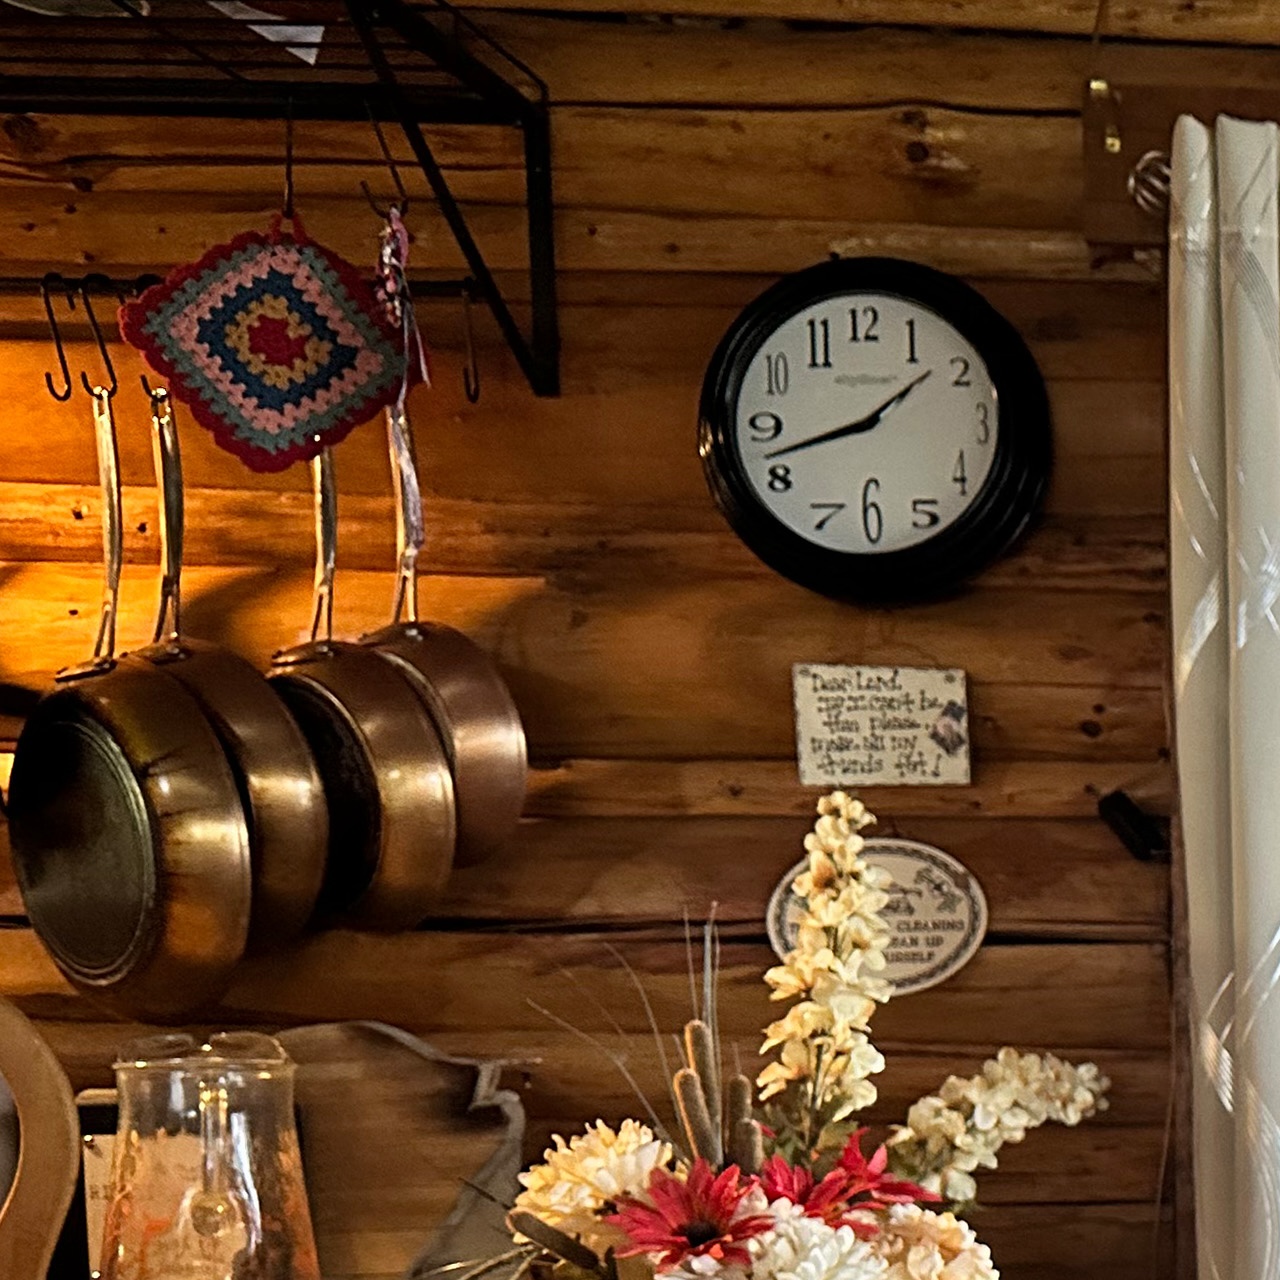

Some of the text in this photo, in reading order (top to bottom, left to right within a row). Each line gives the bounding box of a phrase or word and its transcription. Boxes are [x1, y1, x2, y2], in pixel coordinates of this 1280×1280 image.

[849, 306, 879, 342] 12
[905, 318, 919, 363] 1
[807, 318, 832, 369] 11
[766, 352, 789, 396] 10
[950, 357, 971, 387] 2
[749, 411, 783, 442] 9
[975, 402, 989, 446] 3
[768, 464, 793, 493] 8
[952, 449, 967, 496] 4
[810, 503, 846, 531] 7
[862, 477, 883, 544] 6
[912, 500, 939, 529] 5
[896, 919, 965, 932] CLEANING
[925, 935, 944, 947] UP
